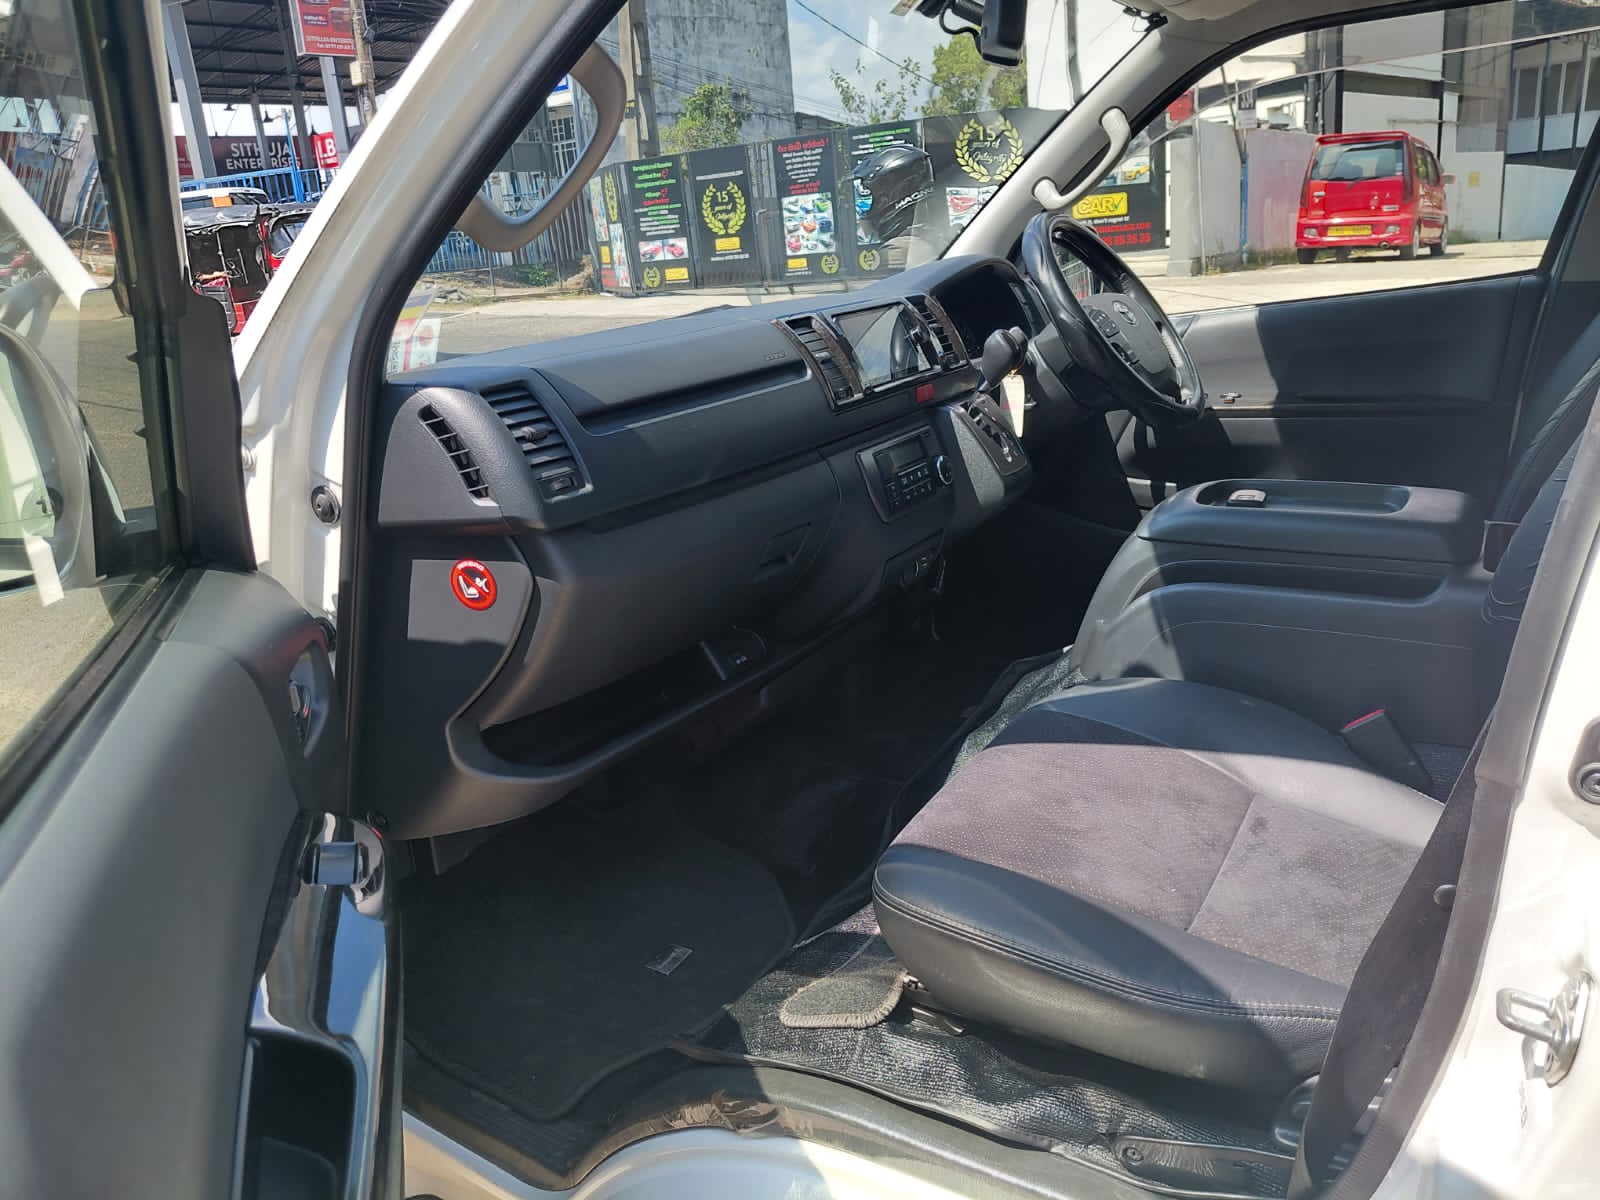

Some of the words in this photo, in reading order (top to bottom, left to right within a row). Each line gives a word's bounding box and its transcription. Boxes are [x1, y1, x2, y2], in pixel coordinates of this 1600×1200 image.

[976, 124, 996, 141] 15
[226, 156, 301, 170] ENTERRISES
[716, 191, 729, 203] 15
